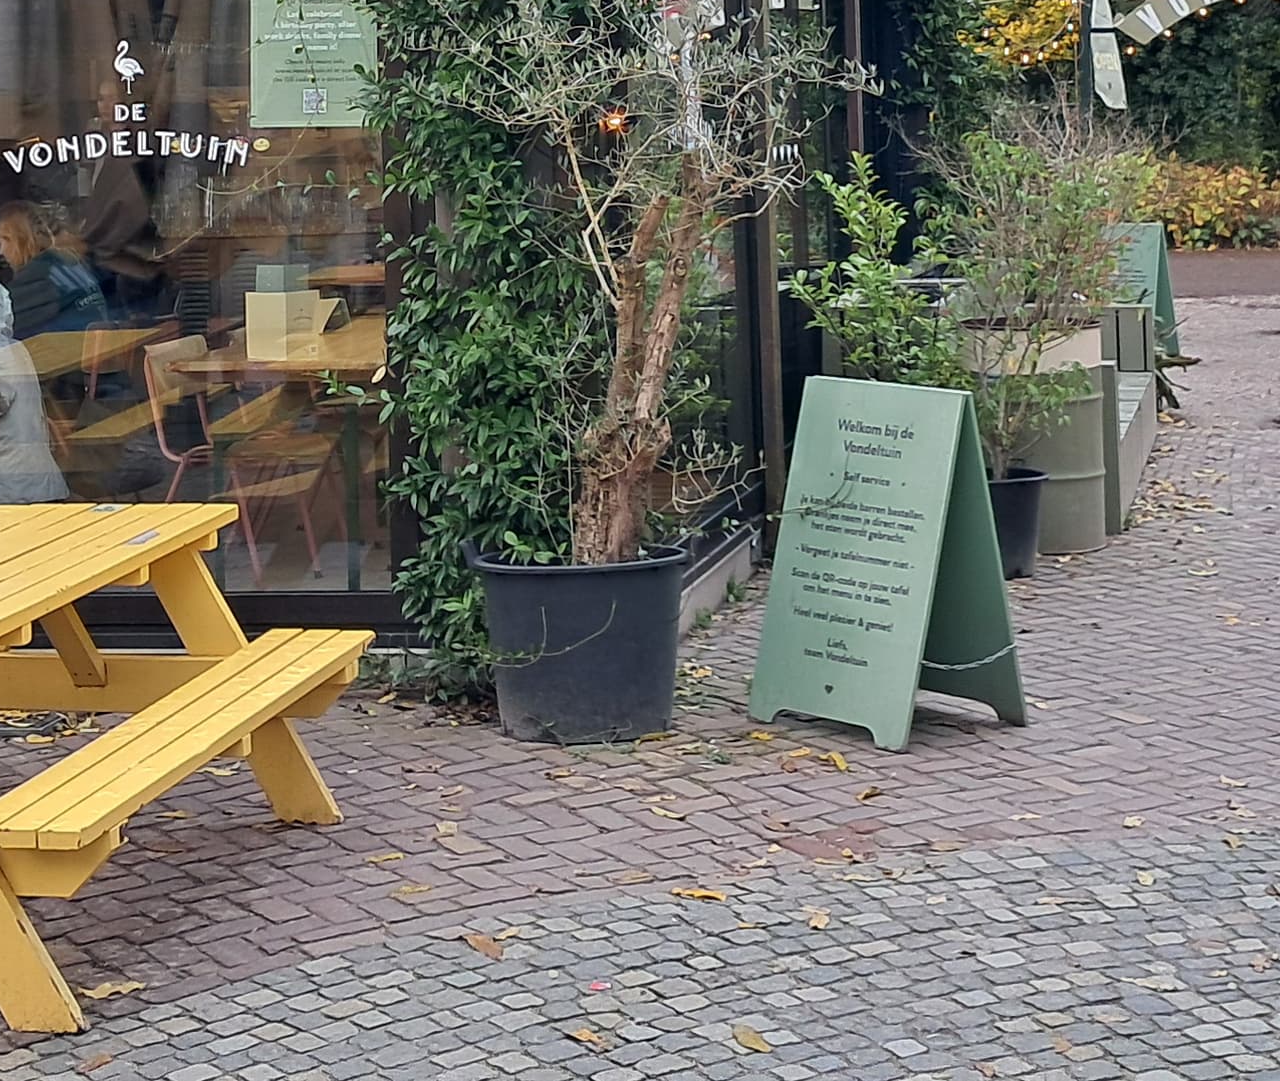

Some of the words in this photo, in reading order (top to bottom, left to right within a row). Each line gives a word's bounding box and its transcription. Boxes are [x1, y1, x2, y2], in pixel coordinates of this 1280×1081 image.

[114, 103, 146, 122] DE
[2, 130, 249, 174] VONDELTUIN
[838, 418, 882, 436] Welkom
[884, 424, 899, 440] bij
[900, 427, 915, 440] de
[843, 439, 902, 459] Vondeltuin
